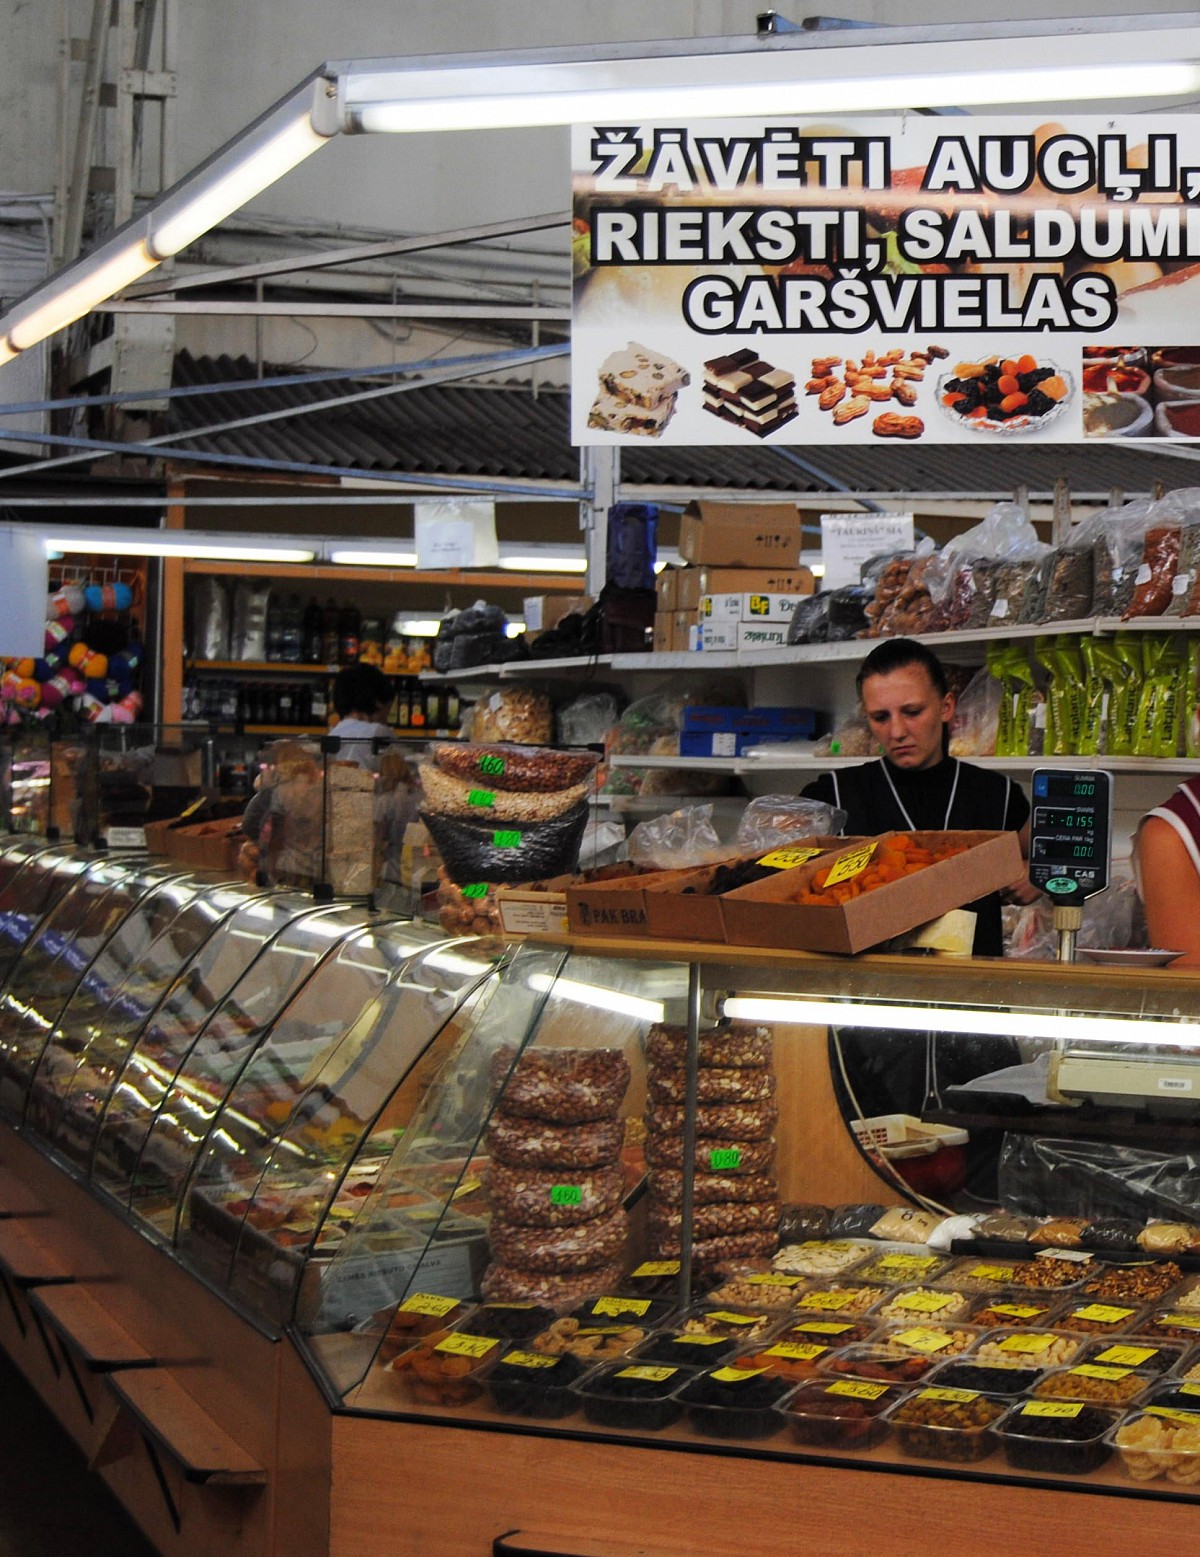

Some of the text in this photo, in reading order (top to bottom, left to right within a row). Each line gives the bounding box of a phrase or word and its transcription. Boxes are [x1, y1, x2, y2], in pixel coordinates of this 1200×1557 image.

[593, 127, 889, 192] ŽĀVĒTI
[592, 207, 884, 271] RIEKSTI,
[684, 270, 1116, 334] GARŠVIELAS
[1074, 869, 1096, 879] CAS
